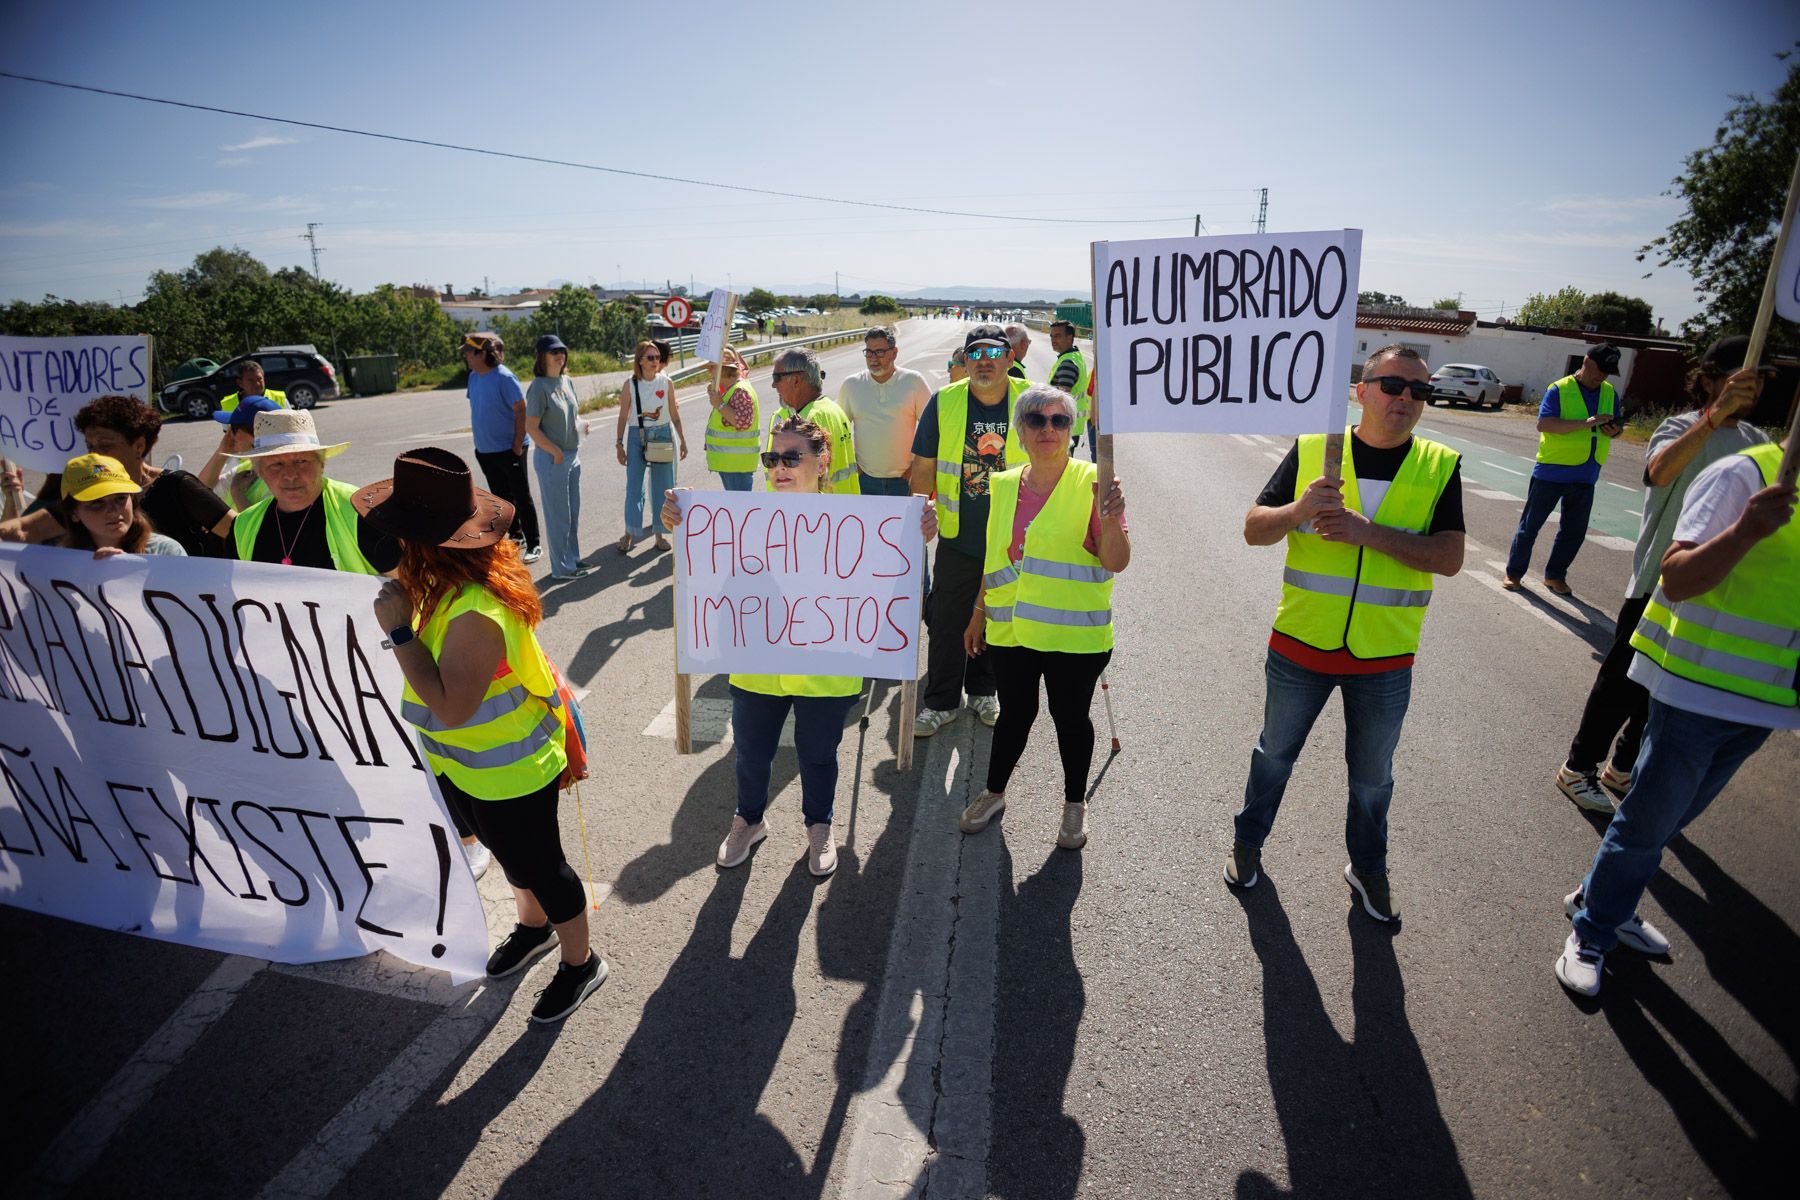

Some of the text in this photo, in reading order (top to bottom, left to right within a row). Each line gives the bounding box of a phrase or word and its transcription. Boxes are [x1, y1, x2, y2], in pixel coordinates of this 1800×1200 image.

[1105, 245, 1347, 328] ALUMBRADO
[0, 346, 146, 394] NTADORES
[1130, 330, 1325, 406] PUBLICO
[0, 414, 76, 452] AGU
[28, 396, 61, 416] DE
[973, 422, 1007, 435] 京都市
[686, 504, 911, 579] PAGAMOS
[693, 595, 911, 652] IMPUESTOS
[0, 742, 131, 871] ÑA
